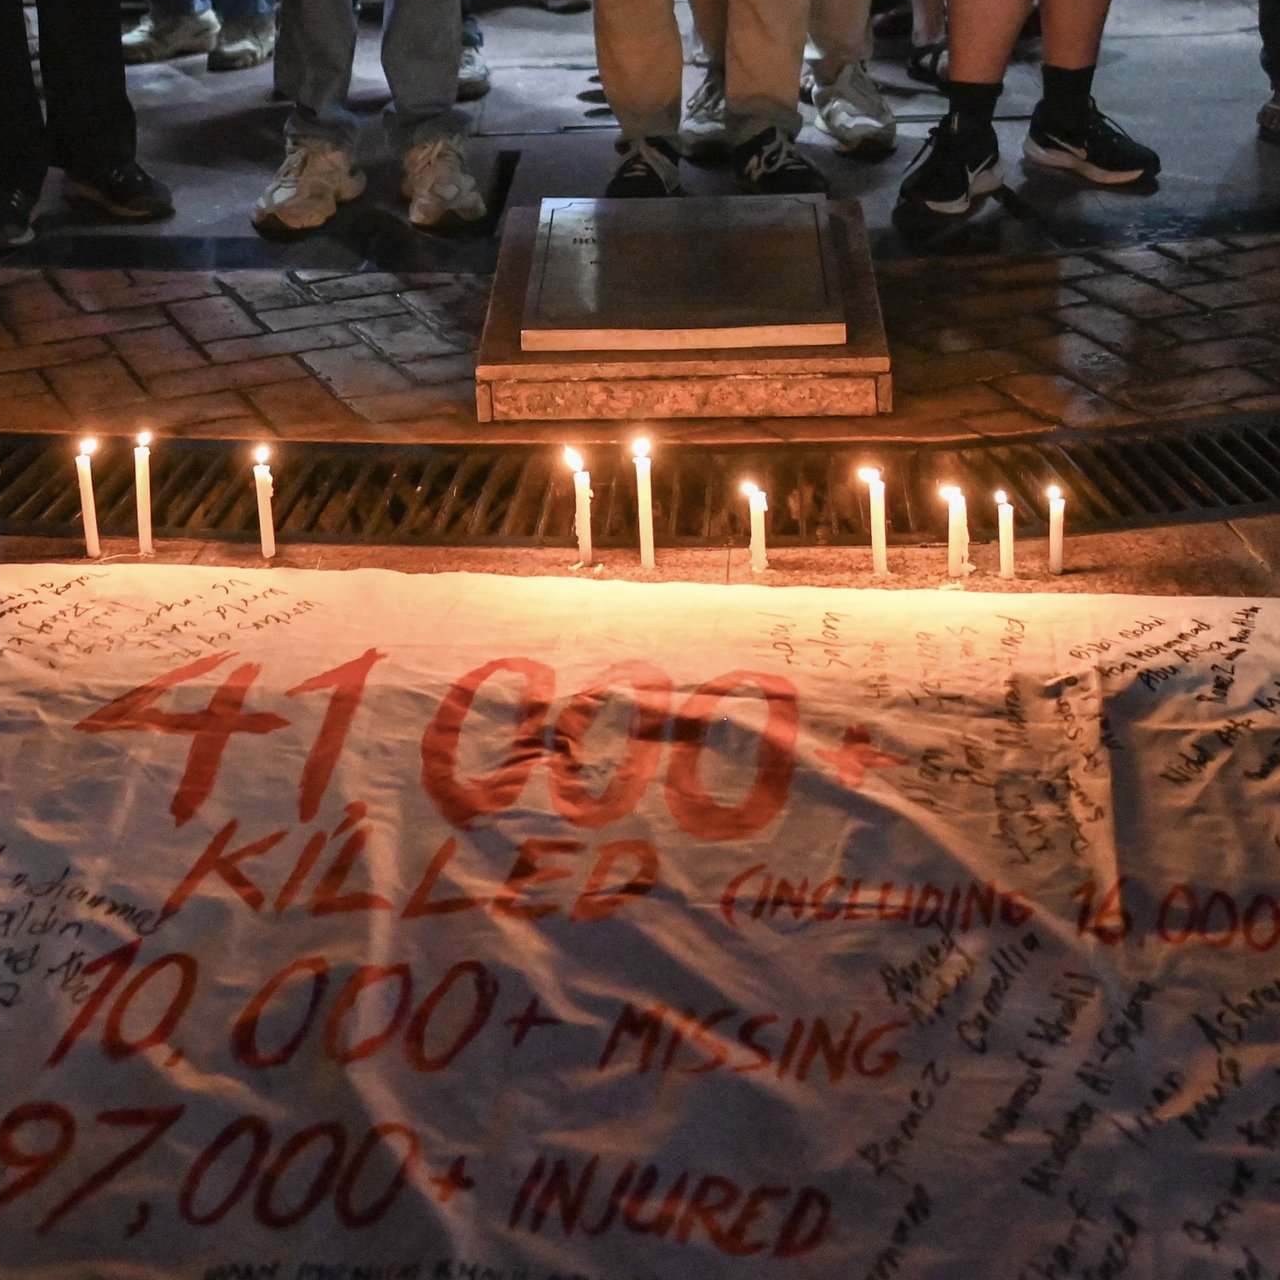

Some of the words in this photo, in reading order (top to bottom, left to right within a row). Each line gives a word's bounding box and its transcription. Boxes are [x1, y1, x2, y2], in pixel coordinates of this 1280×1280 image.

[156, 819, 660, 923] KILLED
[720, 863, 1037, 931] (INCLUDING
[46, 937, 560, 1074] 10,000+
[598, 1001, 911, 1084] MISSING
[508, 1151, 836, 1259] INJURED
